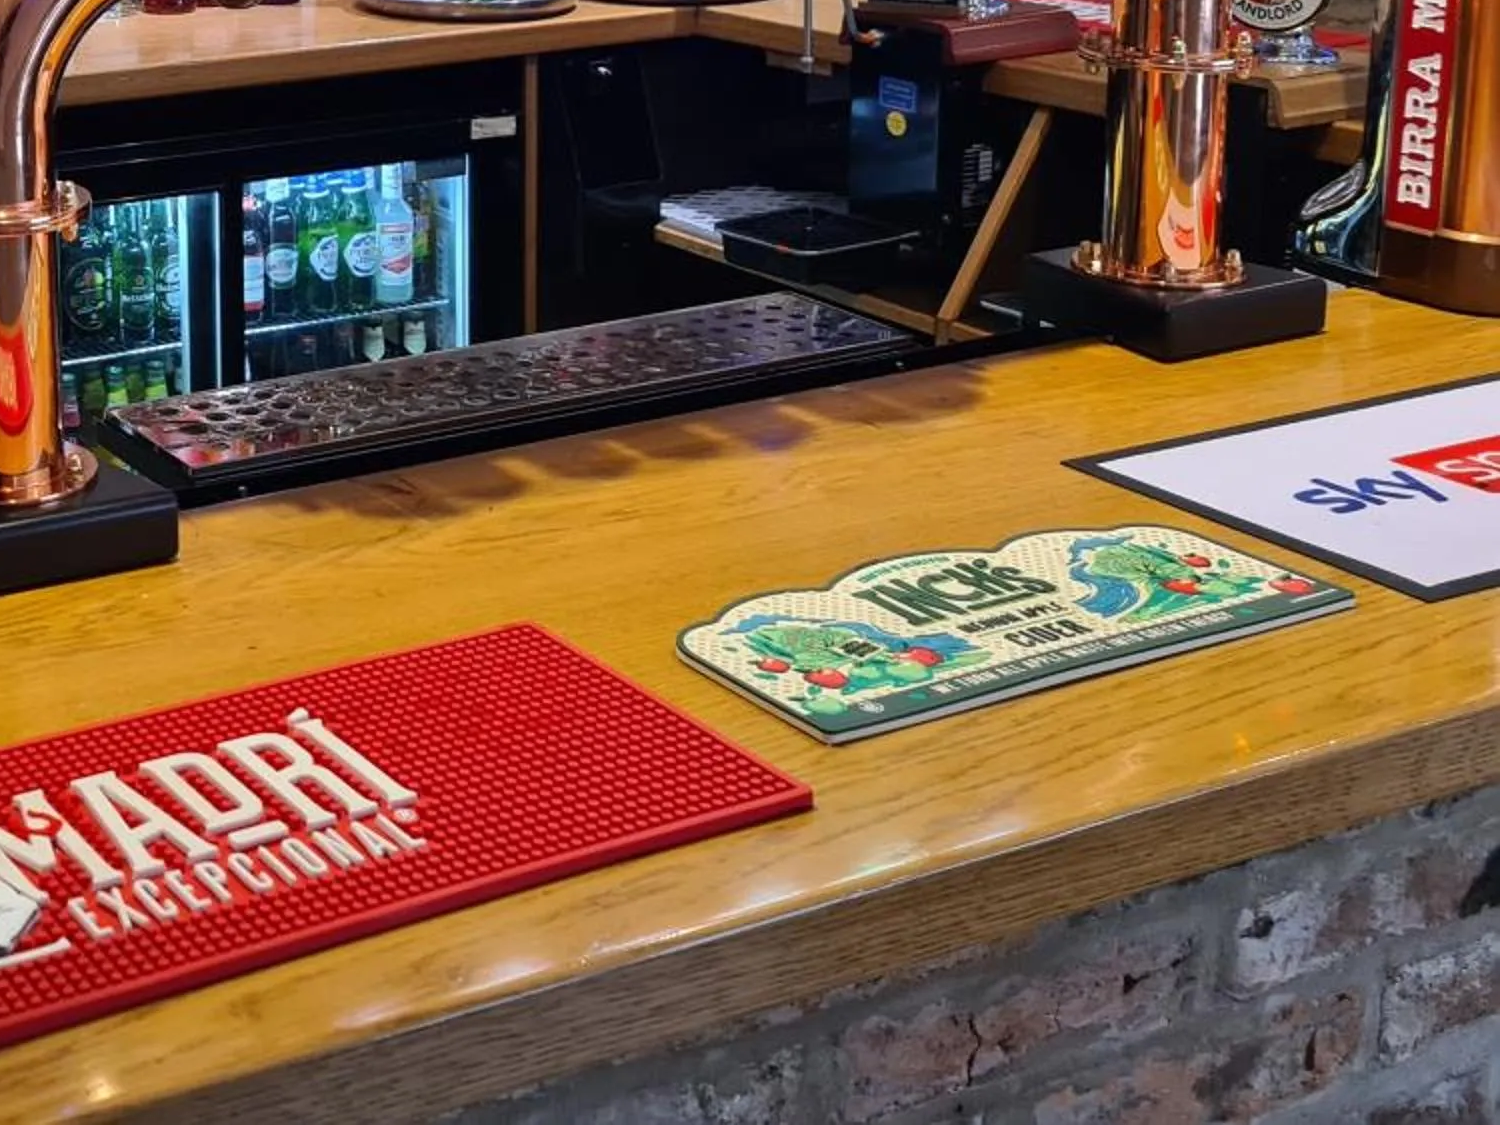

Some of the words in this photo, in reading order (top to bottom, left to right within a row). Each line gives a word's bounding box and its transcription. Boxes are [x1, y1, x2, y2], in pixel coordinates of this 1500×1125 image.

[1397, 52, 1443, 210] BIRRA
[1293, 470, 1449, 515] sky
[1003, 619, 1095, 649] CIDER
[65, 819, 429, 942] EXCEPCIONAL
